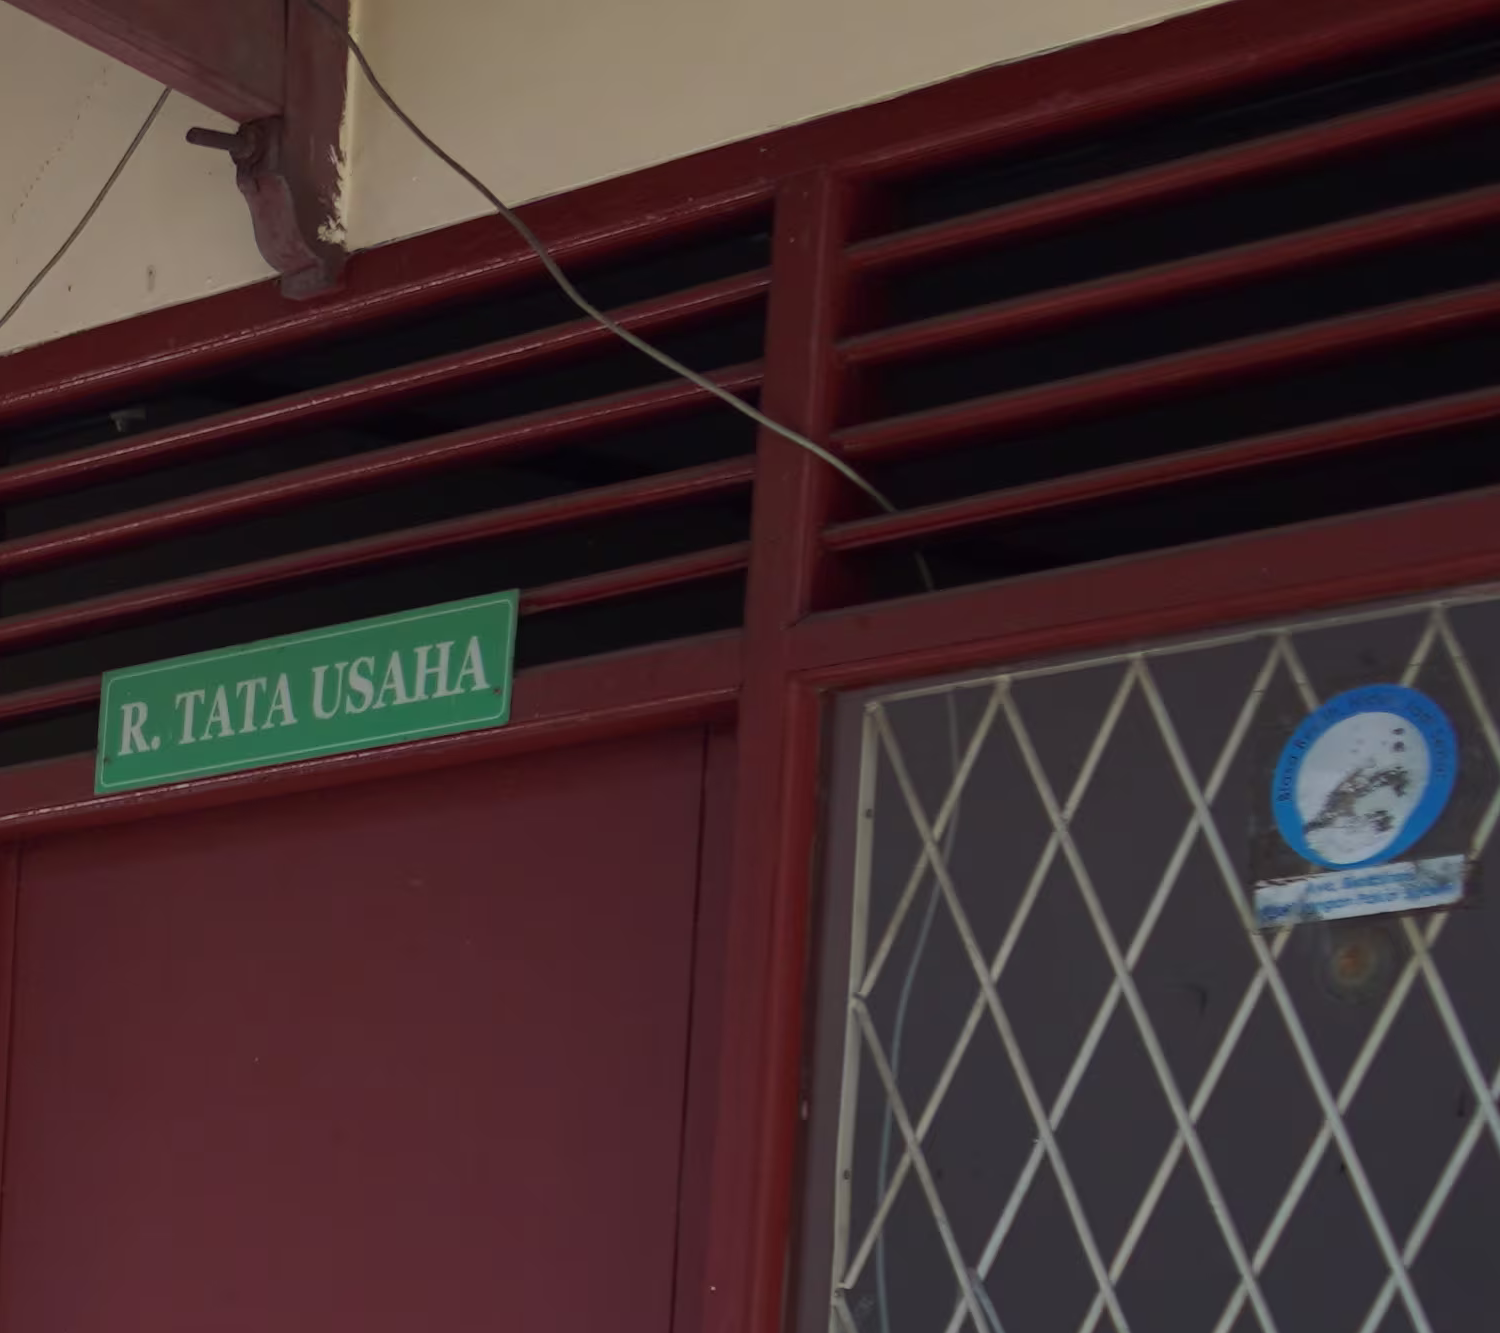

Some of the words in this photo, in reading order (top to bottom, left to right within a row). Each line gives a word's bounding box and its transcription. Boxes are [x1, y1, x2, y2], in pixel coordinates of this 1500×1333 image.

[116, 701, 162, 757] R.
[175, 672, 298, 746] TATA
[311, 635, 491, 721] USAHA
